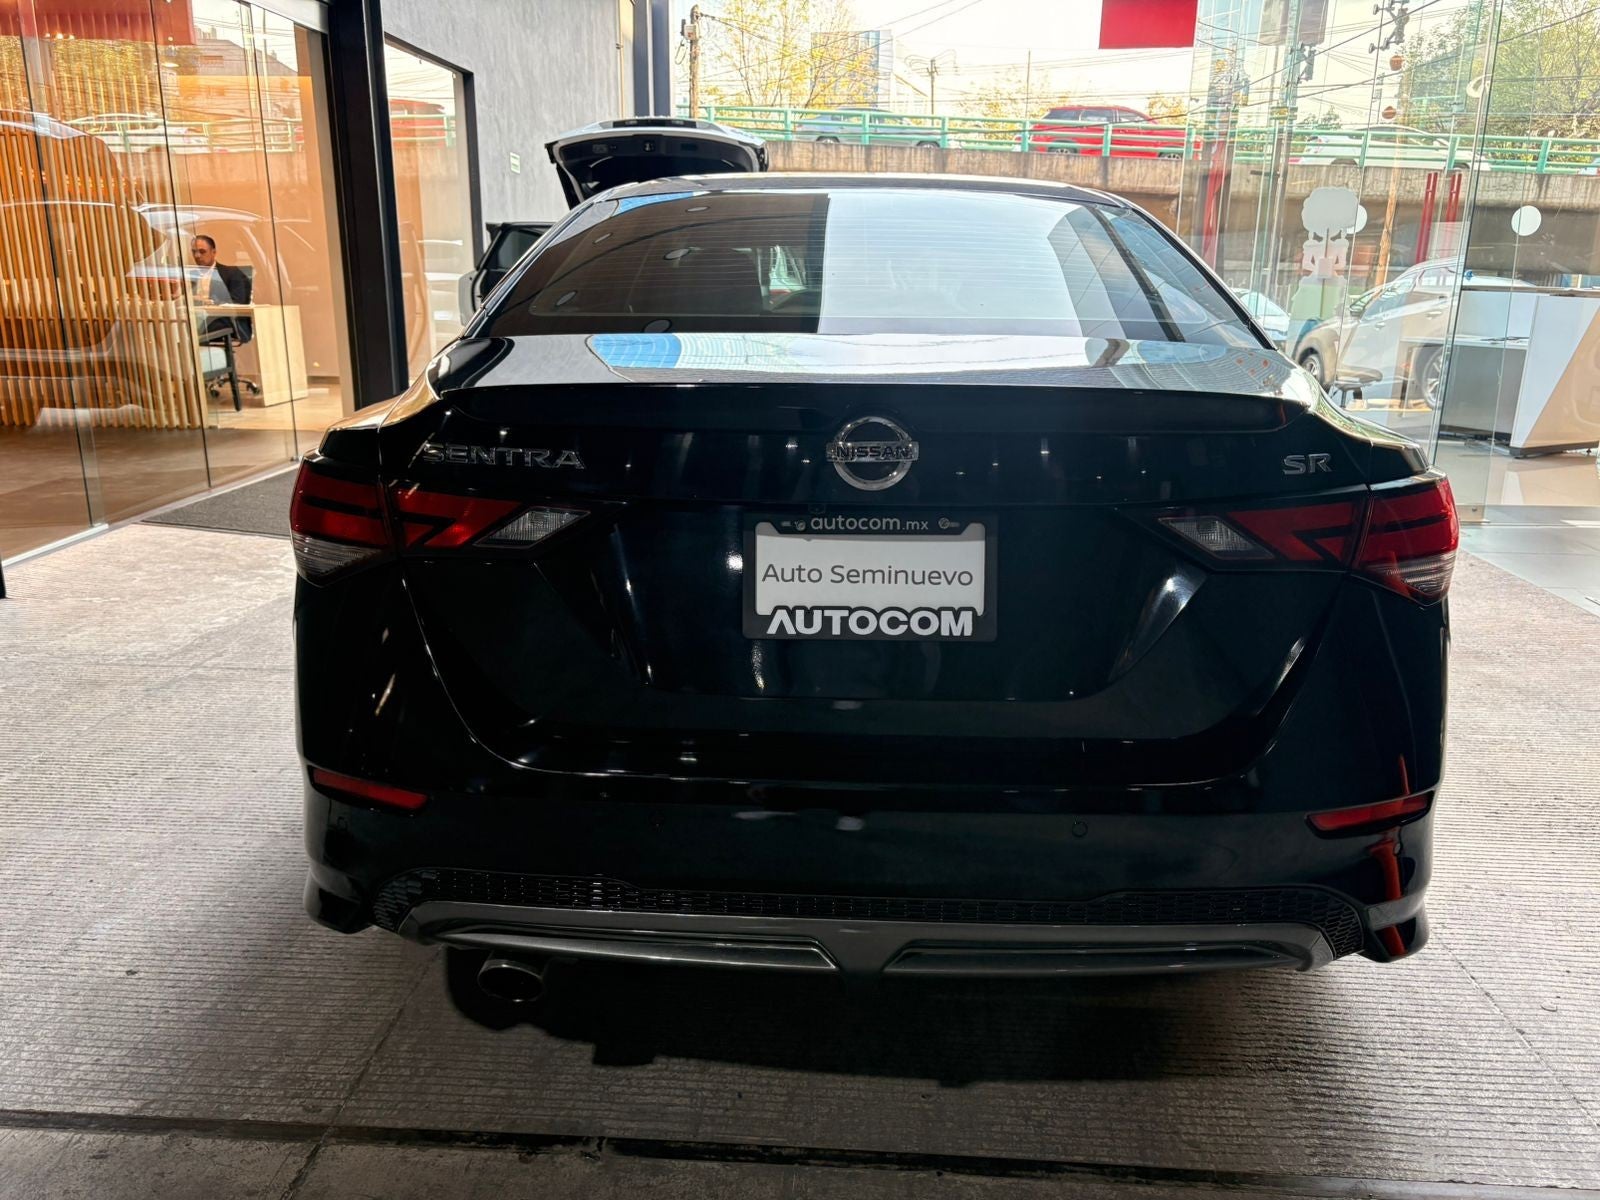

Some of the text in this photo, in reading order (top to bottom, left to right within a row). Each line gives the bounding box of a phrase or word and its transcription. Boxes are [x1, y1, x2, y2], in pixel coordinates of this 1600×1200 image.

[423, 442, 585, 470] SENTRA
[836, 445, 913, 461] NISSAN
[1282, 453, 1333, 475] SR
[810, 514, 929, 531] autocom.mx
[761, 563, 973, 586] Auto Seminuevo
[766, 608, 973, 637] AUTOCOM
